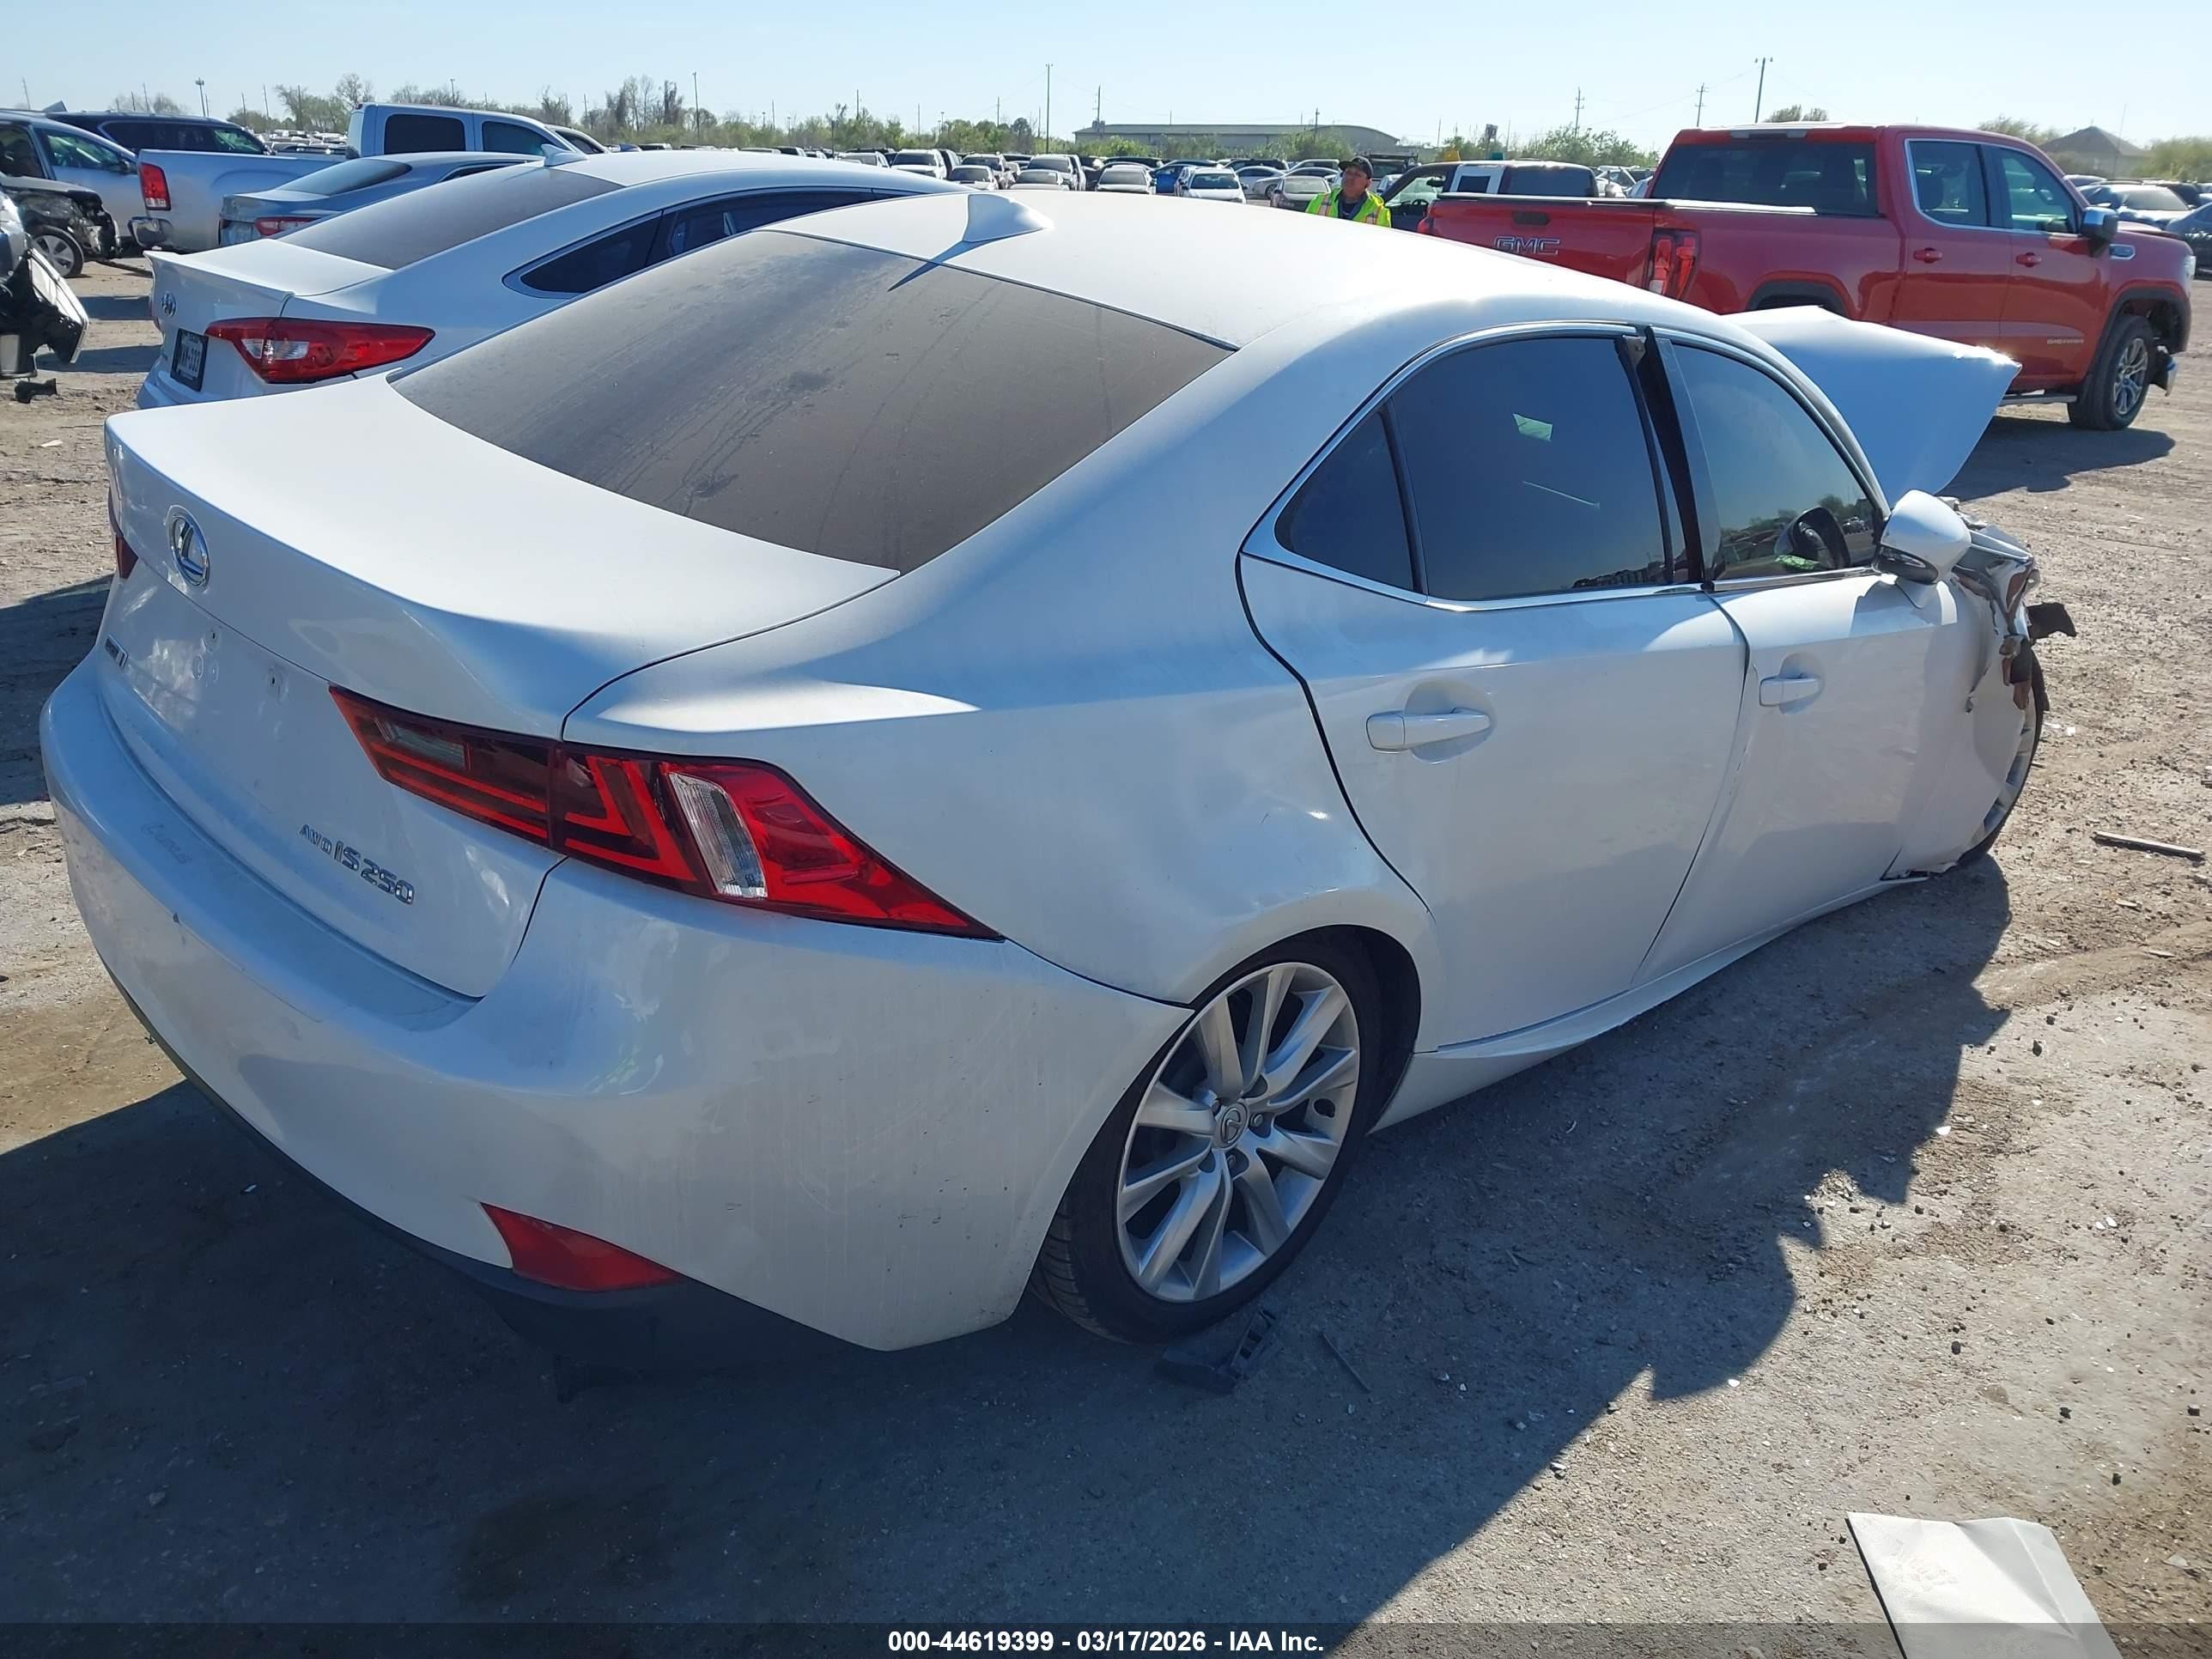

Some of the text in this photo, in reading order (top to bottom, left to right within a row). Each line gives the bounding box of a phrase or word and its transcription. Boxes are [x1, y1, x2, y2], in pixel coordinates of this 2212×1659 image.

[1494, 235, 1560, 255] GMC
[299, 823, 415, 905] AWD IS 250
